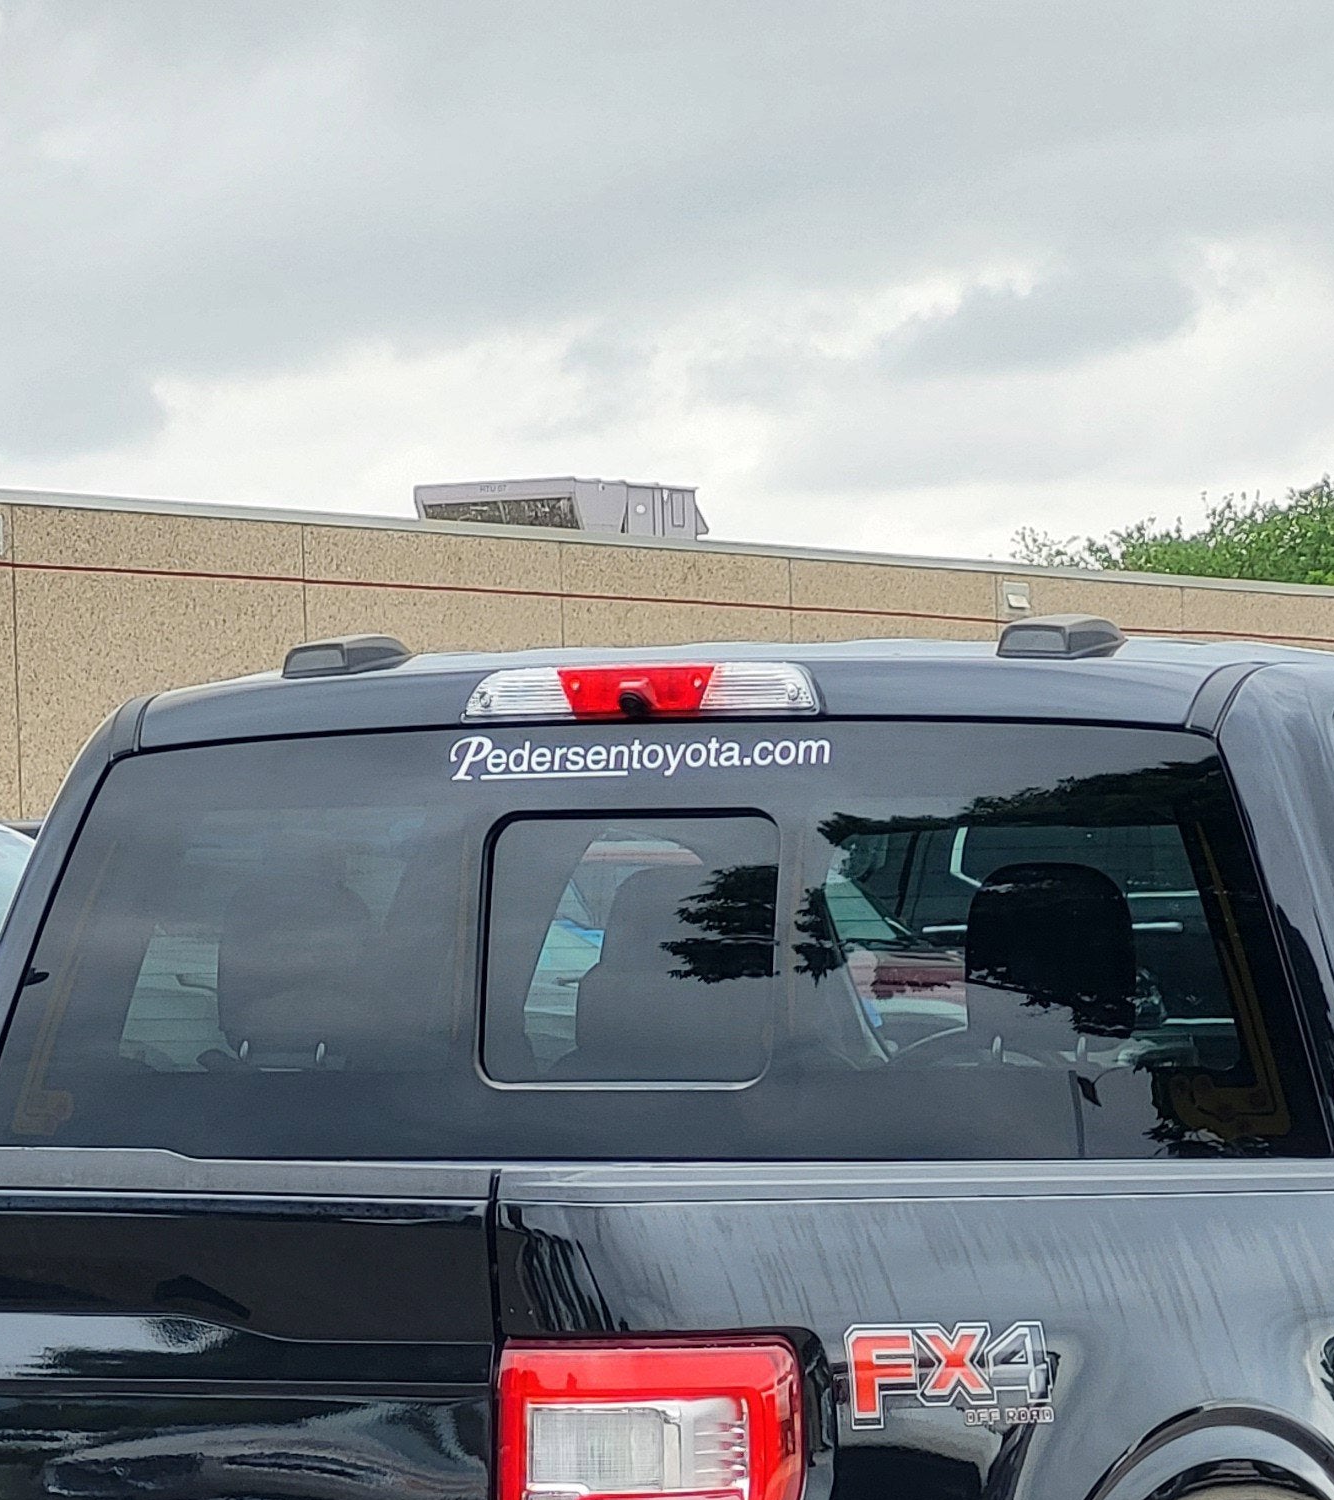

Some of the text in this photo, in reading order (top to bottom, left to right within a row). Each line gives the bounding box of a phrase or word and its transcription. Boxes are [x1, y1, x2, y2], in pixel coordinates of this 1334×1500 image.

[450, 736, 831, 781] Pedersentoyota.com
[844, 1321, 1053, 1430] FX4
[965, 1407, 1054, 1426] OFF ROAD
